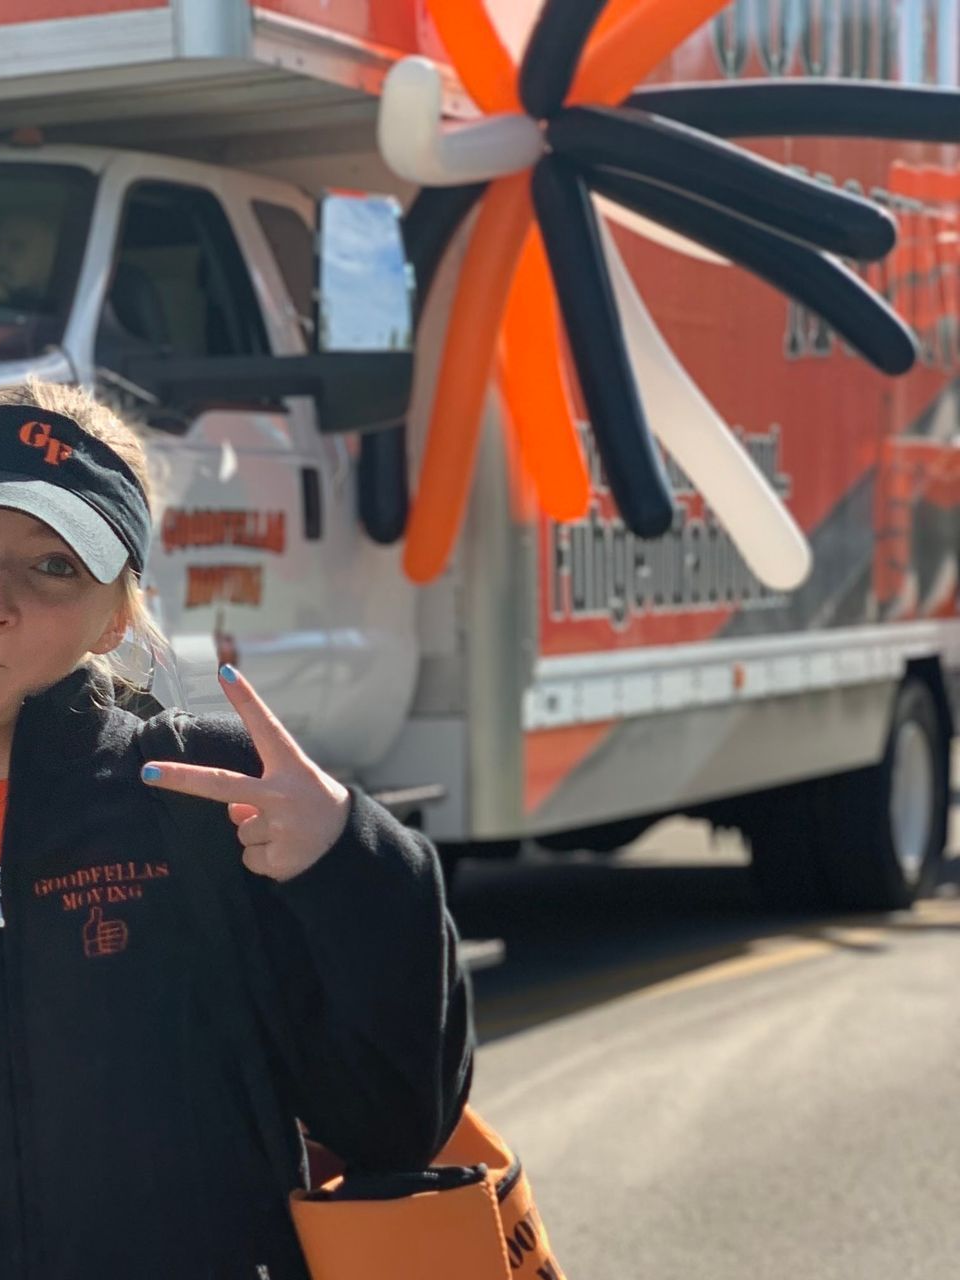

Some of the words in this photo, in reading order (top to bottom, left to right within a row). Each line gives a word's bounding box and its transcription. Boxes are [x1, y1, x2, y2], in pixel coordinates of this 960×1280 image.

[19, 420, 74, 466] GF
[33, 861, 171, 897] GOODFELLAS
[62, 885, 145, 912] MOVING
